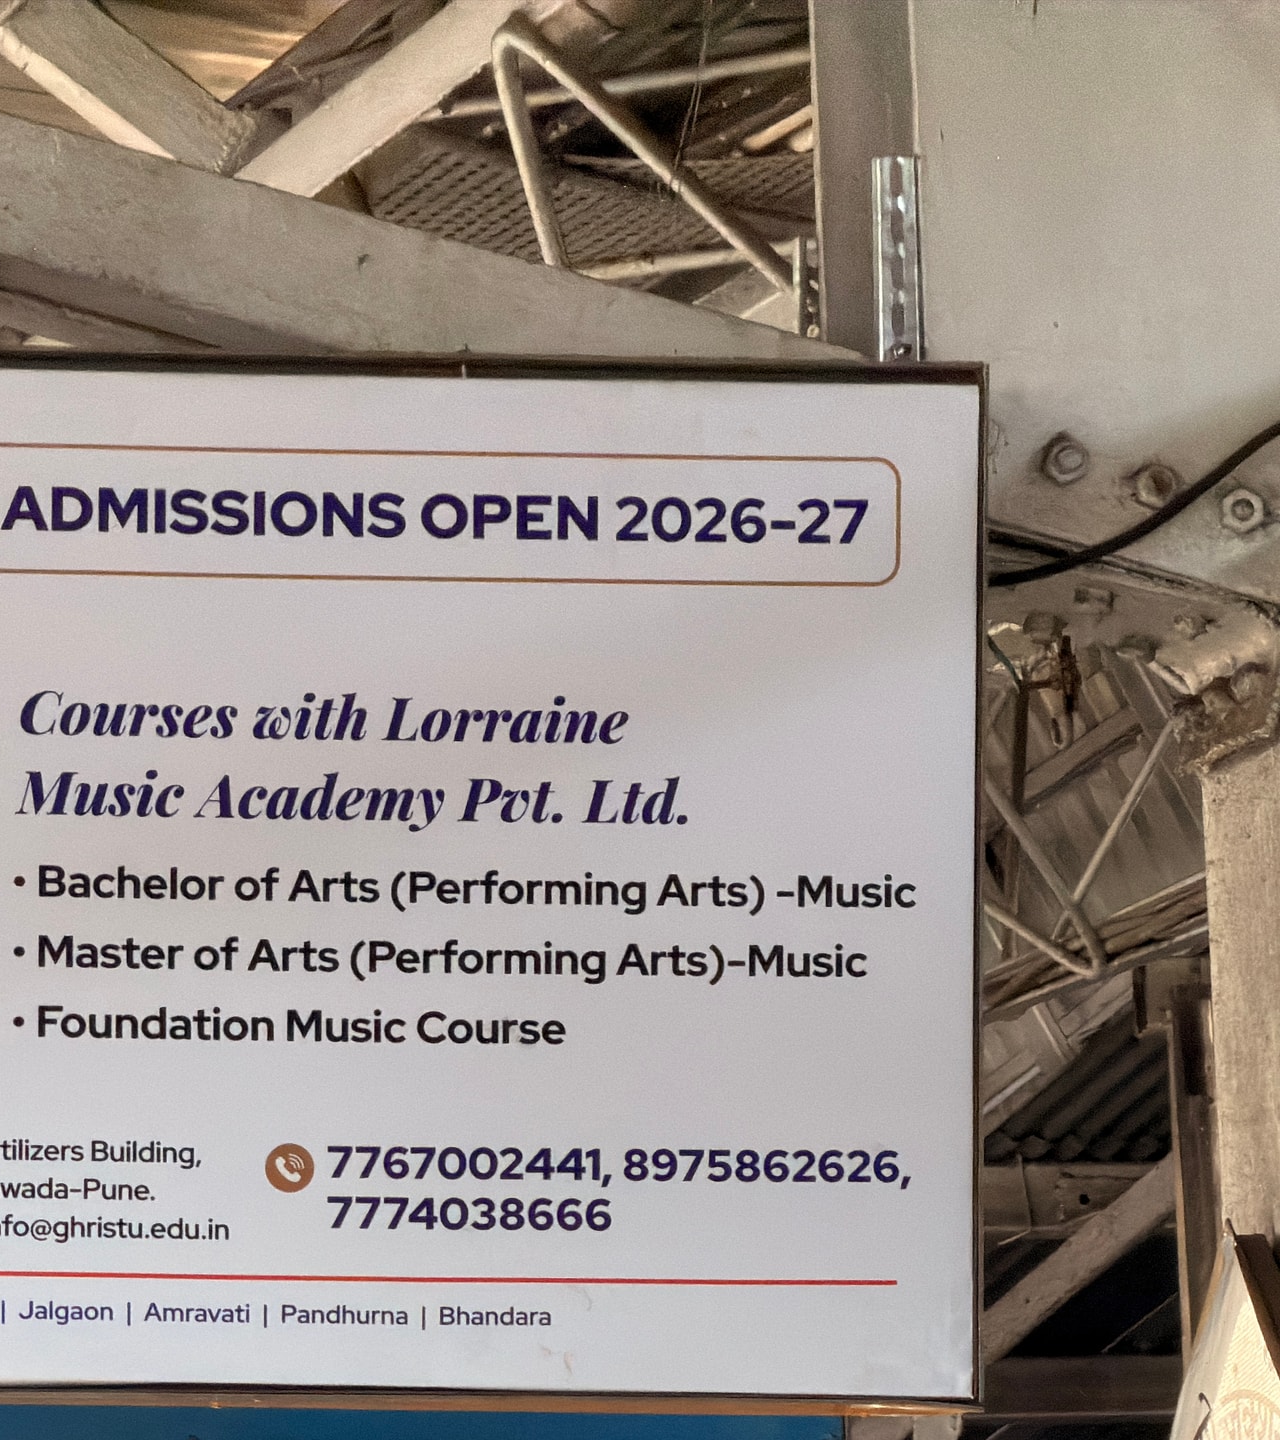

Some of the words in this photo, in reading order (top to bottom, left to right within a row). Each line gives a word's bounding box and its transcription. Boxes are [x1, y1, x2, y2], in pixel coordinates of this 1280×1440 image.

[0, 486, 406, 538] ADMISSIONS
[421, 493, 598, 541] OPEN
[616, 496, 868, 544] 2026-27
[20, 690, 238, 739] Courses
[253, 692, 367, 741] with
[381, 696, 629, 744] Lorraine
[15, 770, 184, 818] Music
[193, 772, 445, 832] Academy
[457, 779, 563, 824] Pvt.
[581, 776, 688, 825] Ltd.
[39, 865, 225, 900] Bachelor
[234, 867, 279, 901] of
[288, 869, 380, 903] Arts
[391, 870, 646, 915] (Performing
[656, 874, 765, 916] Arts)
[777, 874, 916, 908] -Music
[38, 935, 184, 970] Master
[194, 936, 239, 971] of
[248, 939, 339, 972] Arts
[350, 939, 606, 984] (Performing
[616, 943, 867, 985] Arts)-Music
[38, 1005, 274, 1041] Foundation
[287, 1009, 406, 1043] Music
[417, 1011, 566, 1045] Course
[91, 1140, 201, 1169] Building,
[327, 1146, 612, 1188] 7767002441,
[623, 1148, 911, 1190] 8975862626,
[327, 1196, 612, 1231] 7774038666
[19, 1301, 113, 1325] Jalgaon
[144, 1303, 249, 1323] Amravati
[282, 1304, 408, 1325] Pandhurna
[440, 1306, 551, 1326] Bhandara
